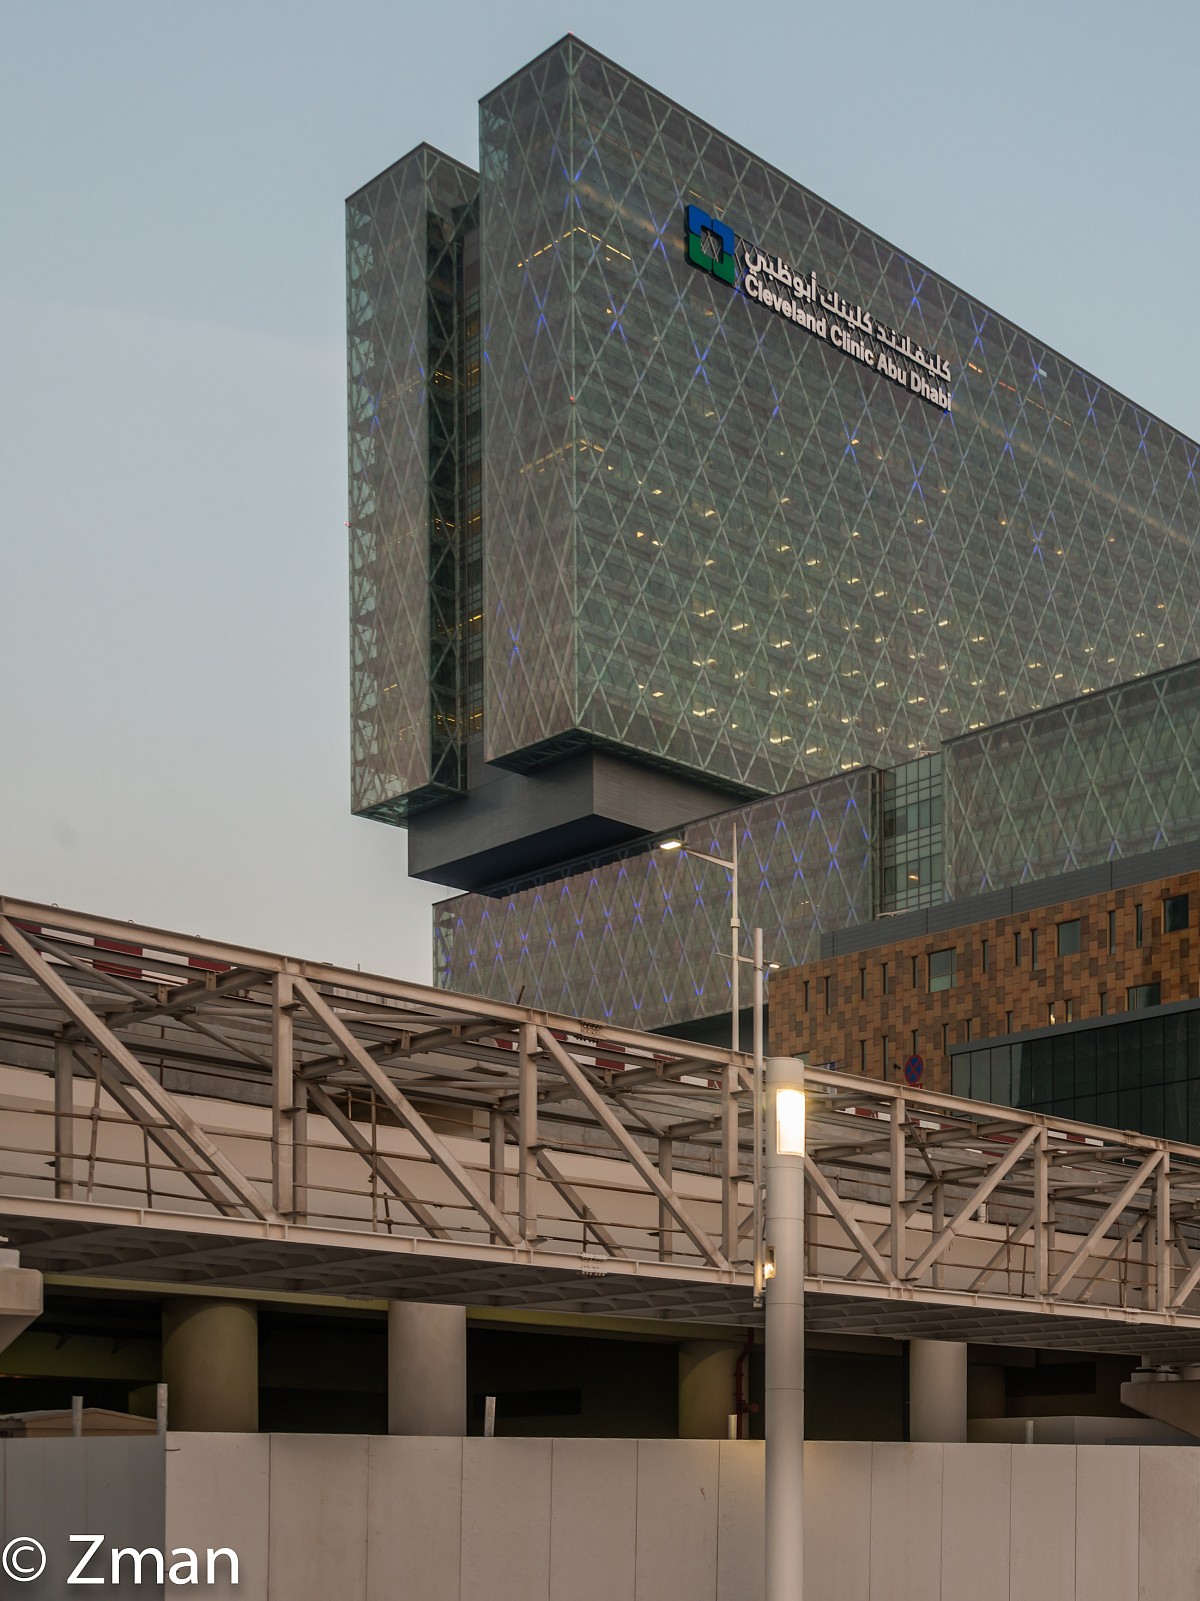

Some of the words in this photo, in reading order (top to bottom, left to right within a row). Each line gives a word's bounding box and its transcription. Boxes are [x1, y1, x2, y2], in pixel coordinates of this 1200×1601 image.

[745, 252, 817, 303] أبوظبي
[820, 292, 872, 335] كلينك
[745, 274, 826, 338] Cleveland
[830, 325, 874, 366] Clinic
[877, 353, 907, 386] Abu
[911, 371, 952, 411] Dhabi
[877, 326, 951, 382] كليفلاند
